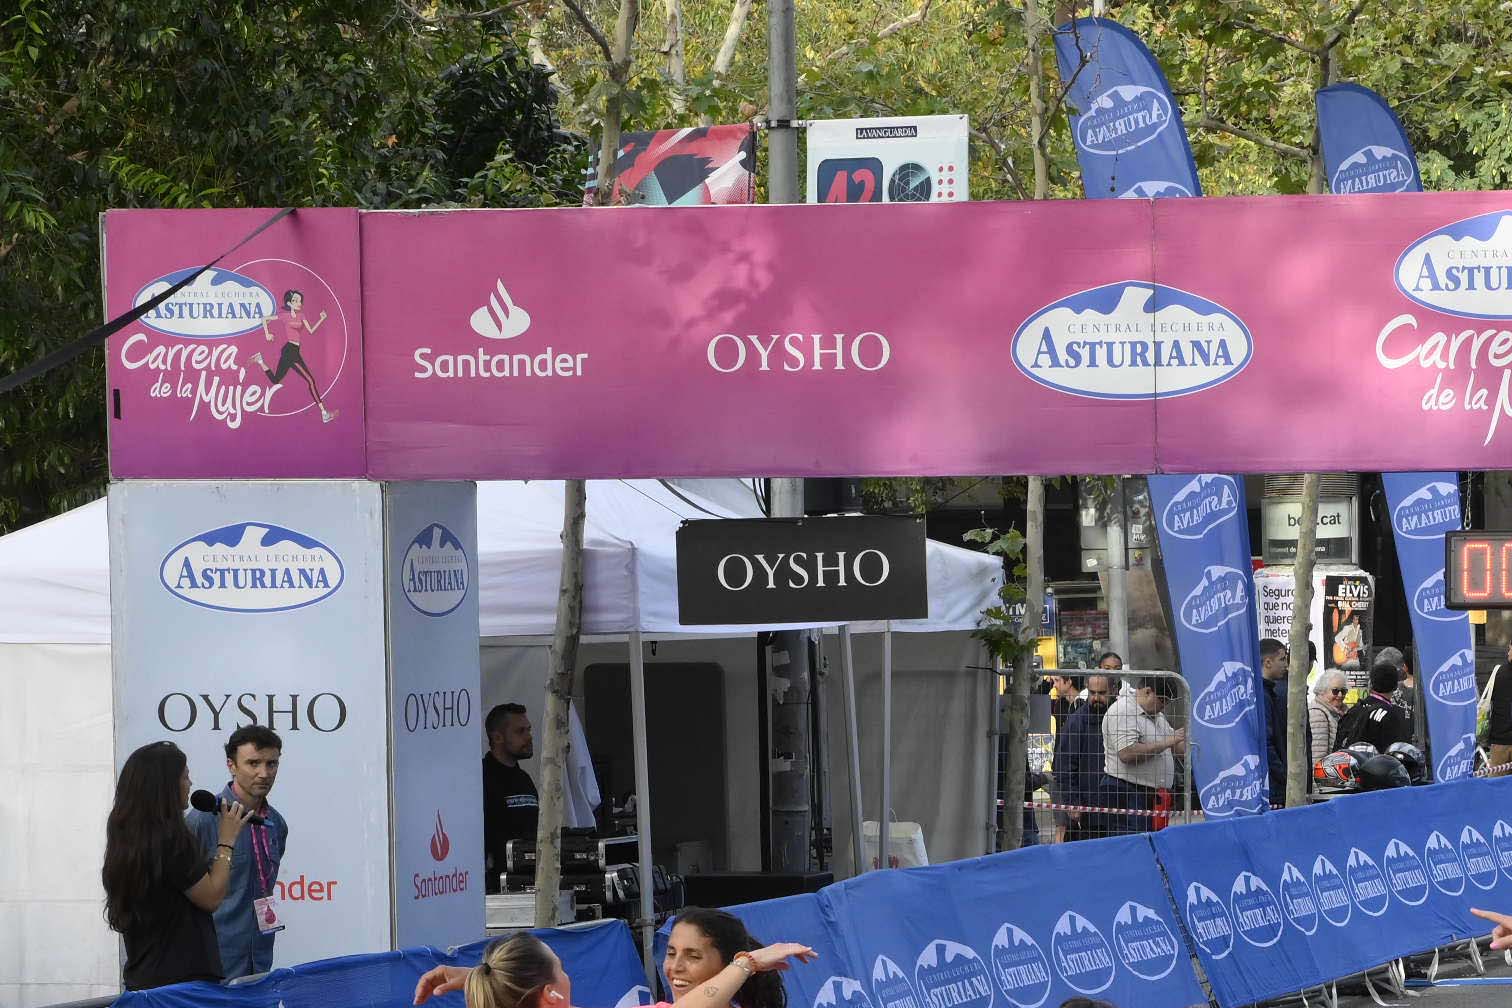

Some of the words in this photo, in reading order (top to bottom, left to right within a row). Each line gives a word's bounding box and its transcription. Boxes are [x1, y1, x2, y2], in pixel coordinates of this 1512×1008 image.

[1068, 323, 1143, 334] CENTRAL
[1151, 322, 1226, 333] LECHERA
[121, 333, 239, 370] Carrera
[414, 347, 588, 380] Santander
[707, 332, 891, 372] OYSHO
[1031, 326, 1234, 369] ASTURIANA
[150, 373, 172, 398] de
[177, 373, 193, 398] la
[189, 367, 284, 429] Mujer
[1421, 371, 1456, 411] de
[1464, 371, 1488, 410] la
[174, 556, 332, 590] ASTURIANA
[202, 554, 260, 563] CENTRAL
[266, 553, 324, 563] LECHERA
[717, 549, 890, 591] OYSHO
[407, 558, 466, 594] ASTURIANA
[1338, 584, 1369, 597] ELVIS
[1263, 601, 1280, 614] que
[158, 692, 347, 733] OYSHO
[405, 688, 471, 733] OYSHO
[413, 867, 470, 900] Santander
[997, 959, 1048, 990] ASTURIANA
[1058, 945, 1113, 977] ASTURIANA
